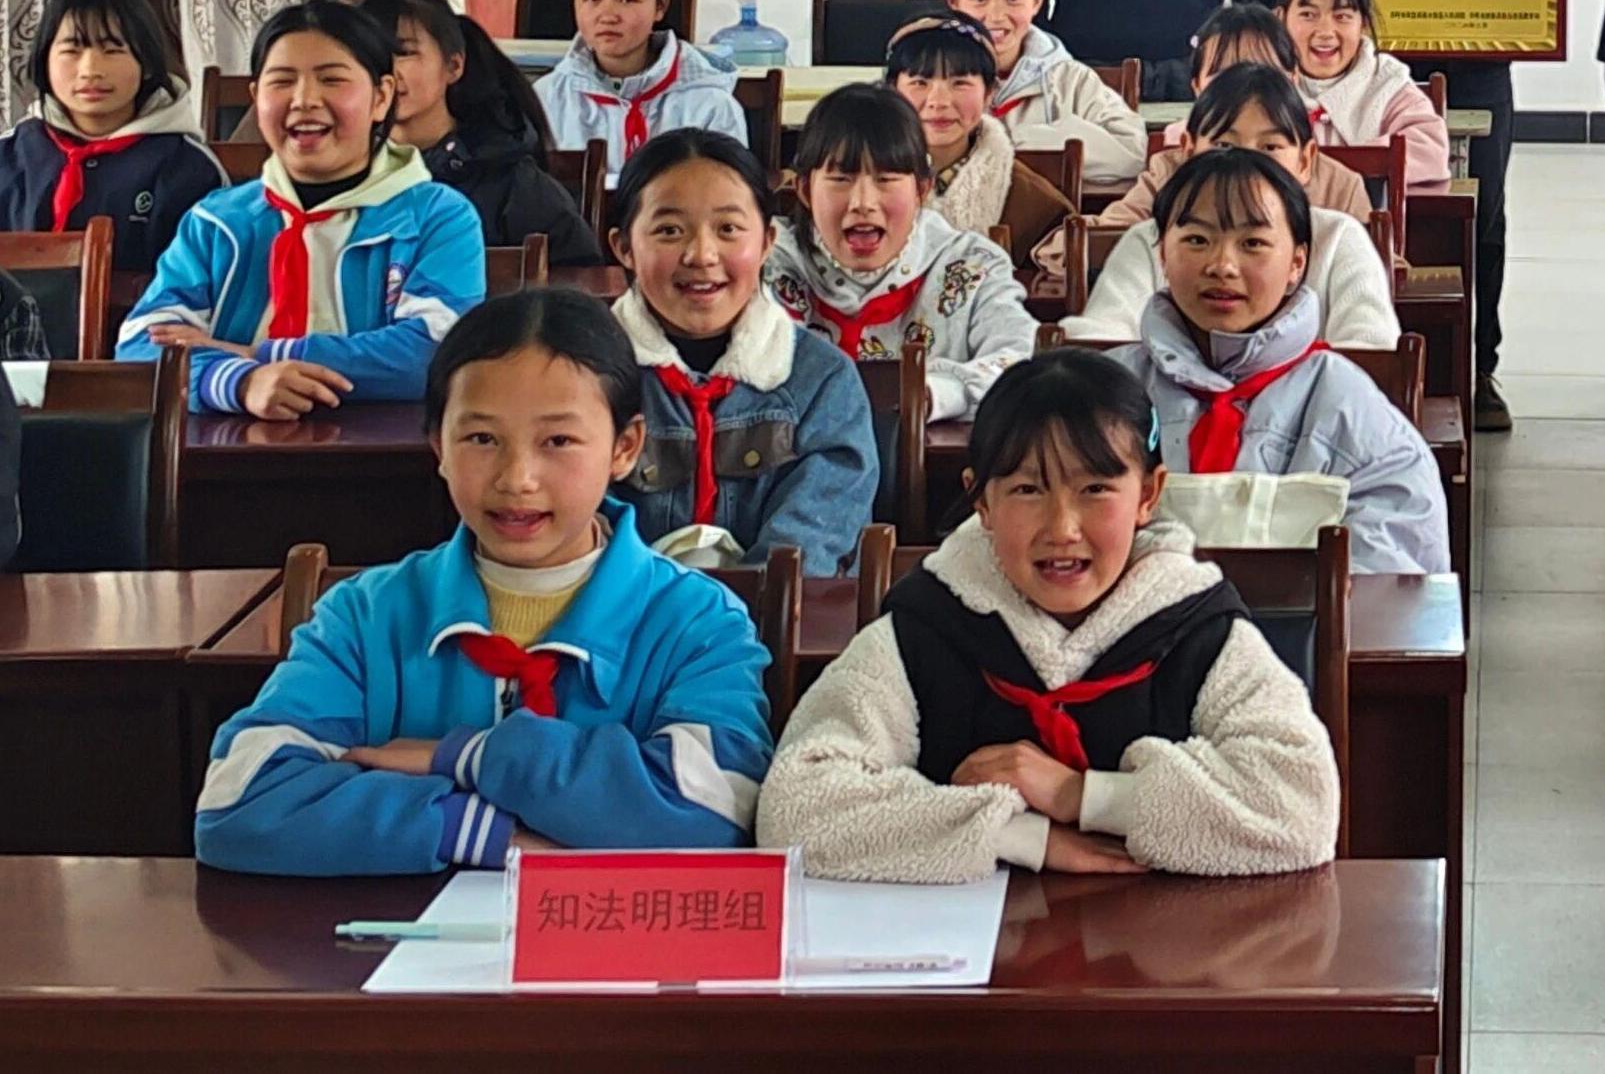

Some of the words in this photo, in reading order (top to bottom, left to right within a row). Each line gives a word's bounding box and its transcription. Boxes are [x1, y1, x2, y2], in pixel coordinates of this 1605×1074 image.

[536, 888, 768, 934] 知法明理组
